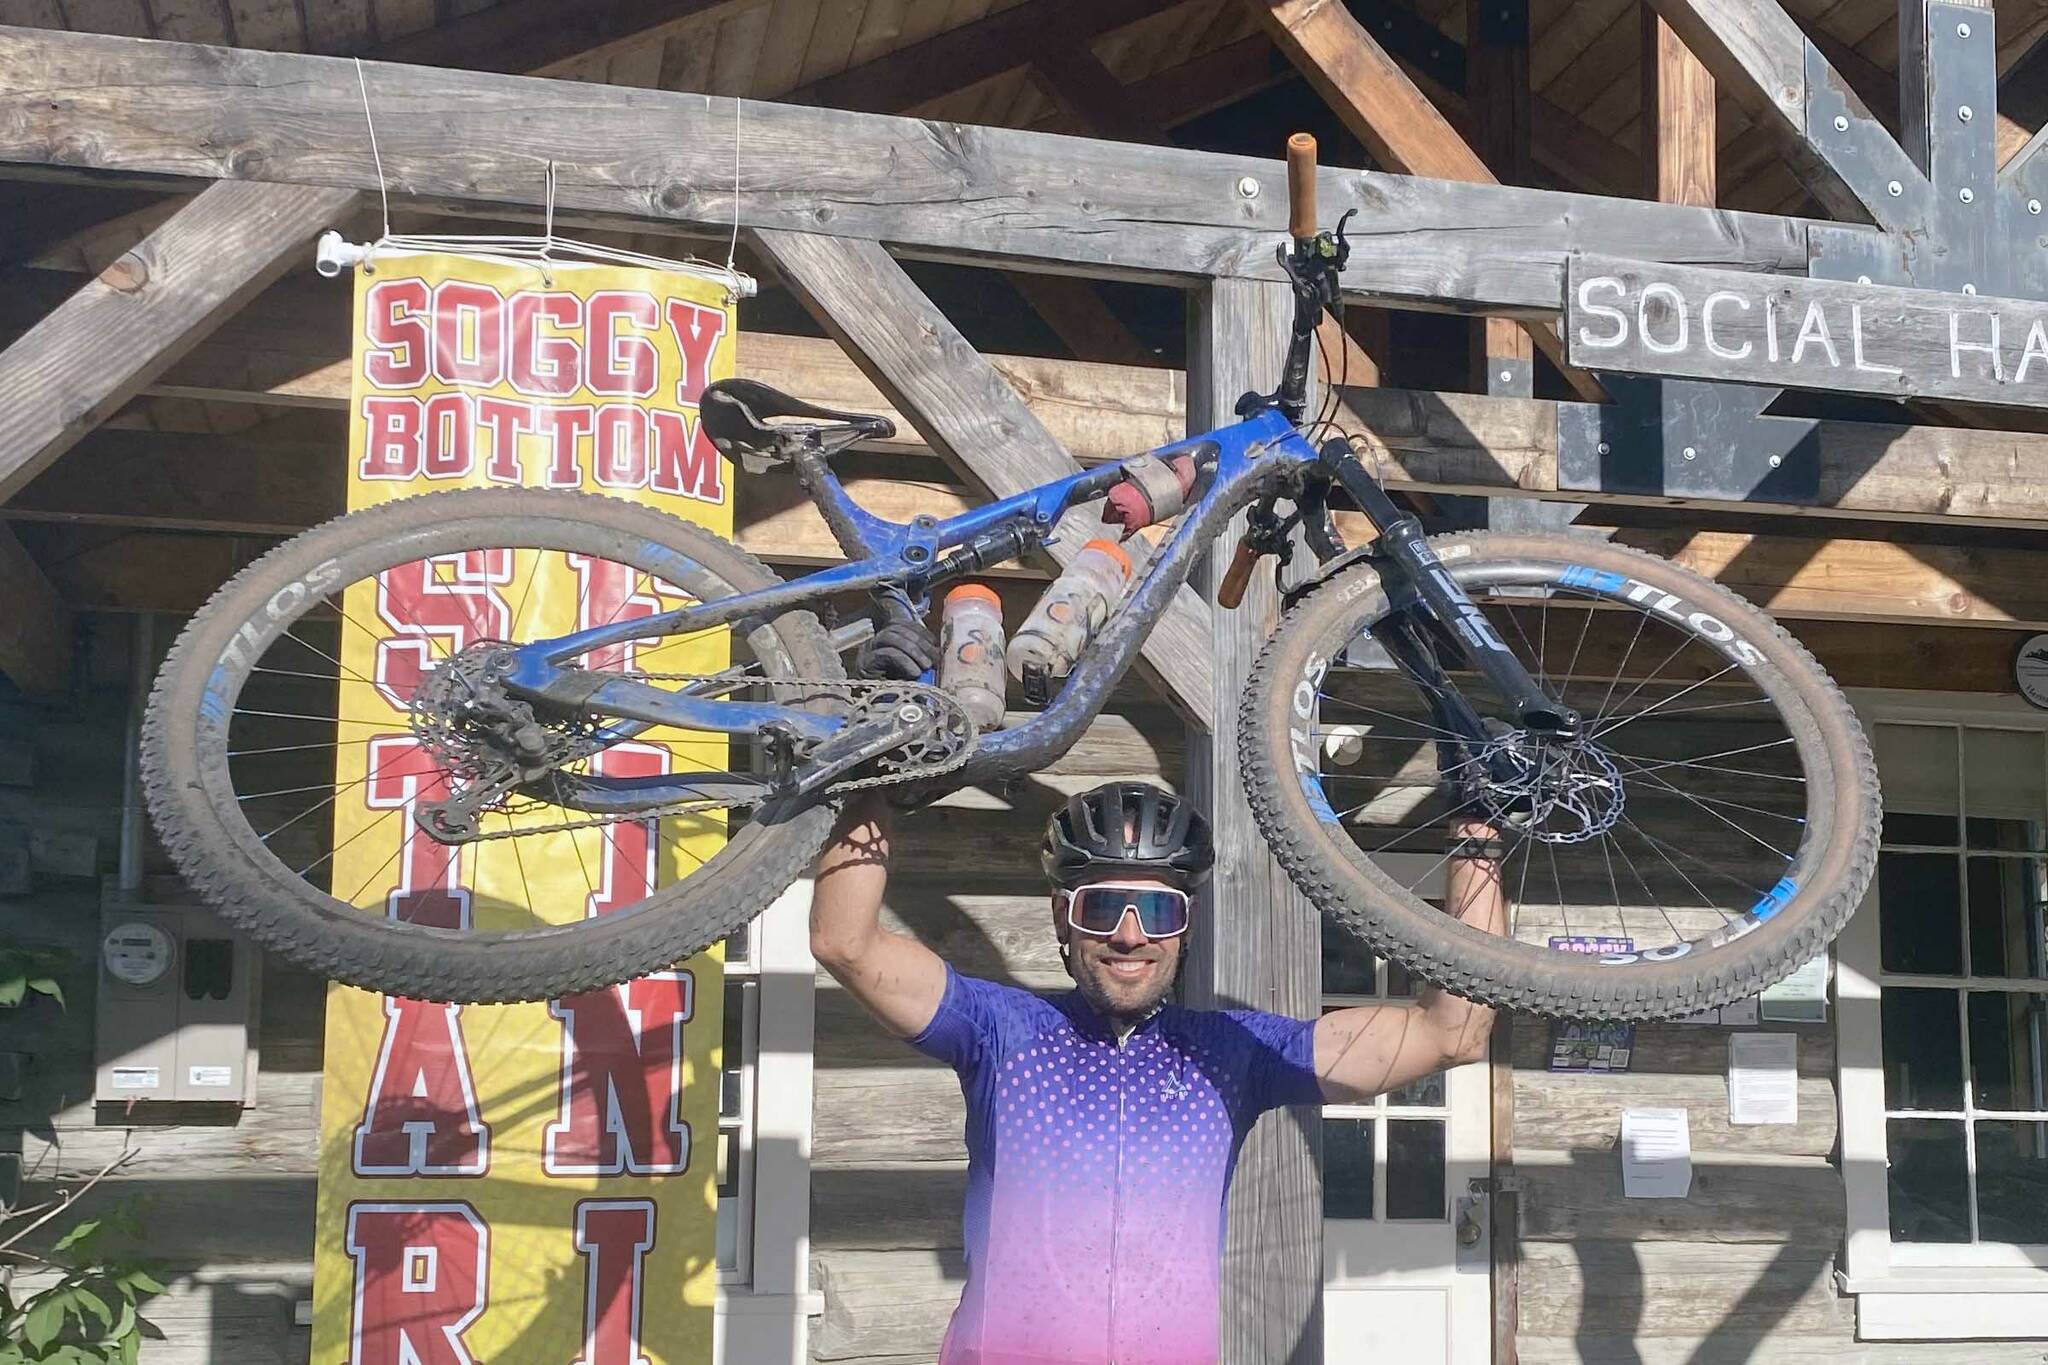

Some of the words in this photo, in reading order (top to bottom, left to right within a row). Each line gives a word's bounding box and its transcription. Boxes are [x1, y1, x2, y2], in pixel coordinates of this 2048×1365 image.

[362, 278, 727, 408] SOGGY
[1578, 276, 1904, 374] SOCIAL
[359, 391, 725, 505] BOTTOM
